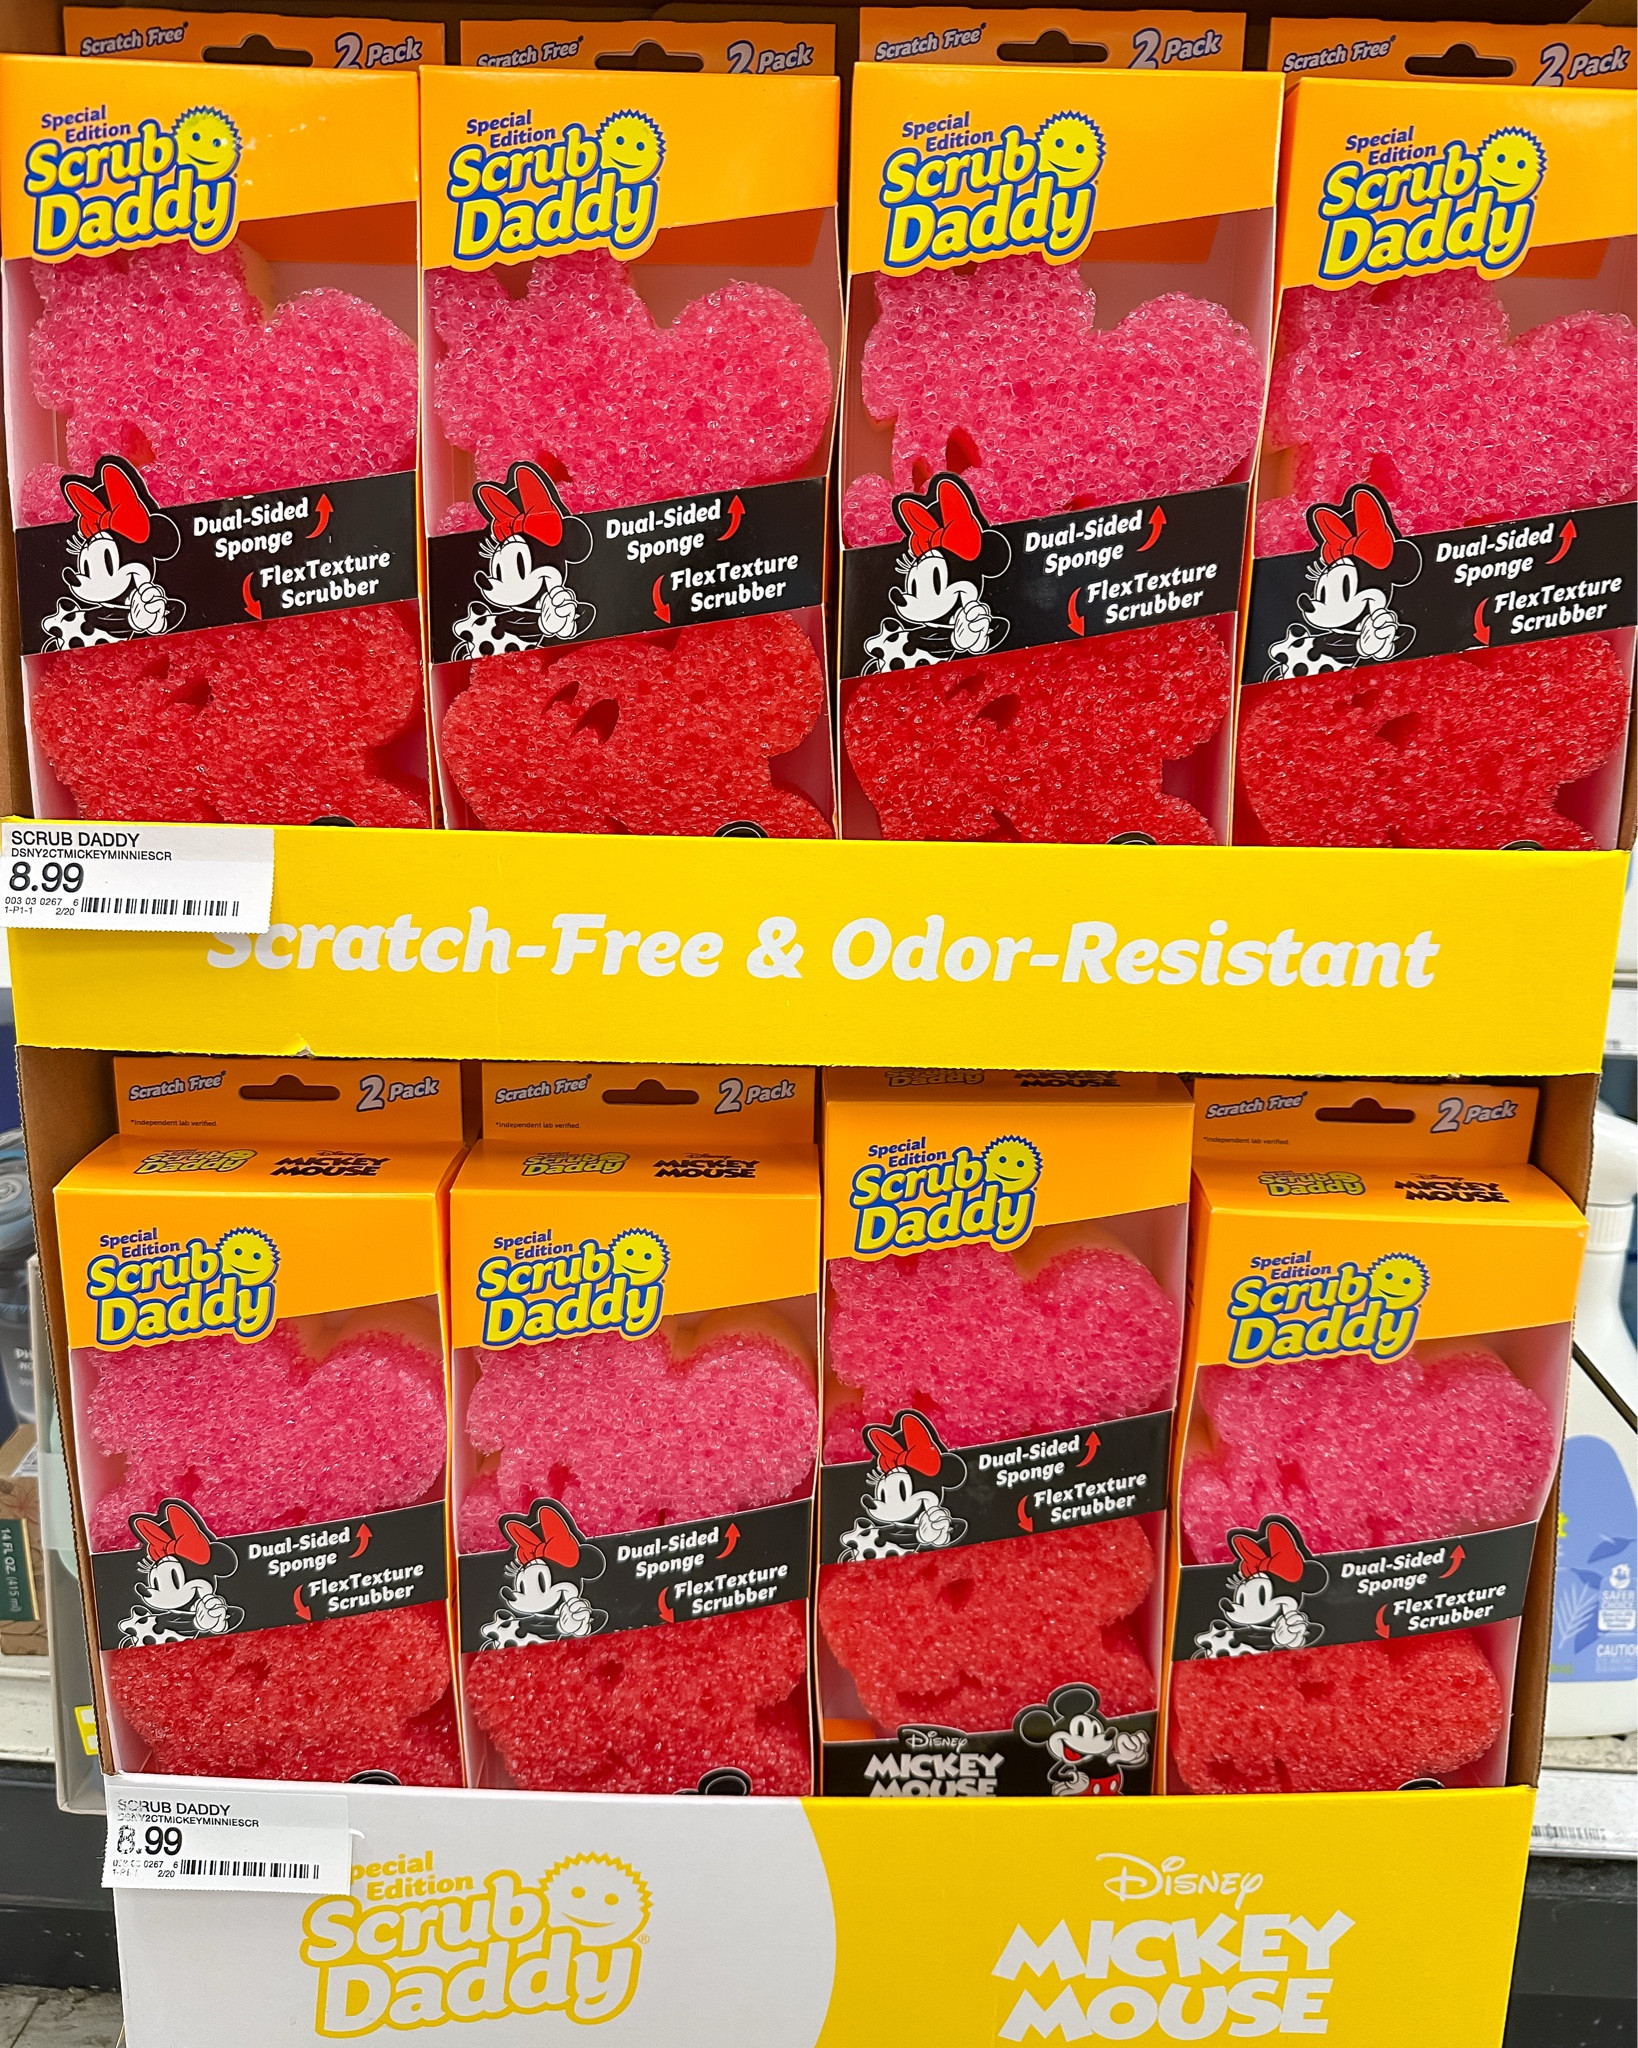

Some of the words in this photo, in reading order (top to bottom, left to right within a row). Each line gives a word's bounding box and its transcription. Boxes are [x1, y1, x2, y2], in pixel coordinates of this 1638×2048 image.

[81, 30, 142, 56] Scratch
[334, 32, 363, 69] 2
[365, 37, 421, 68] Pack
[477, 46, 537, 67] Scratch
[726, 39, 754, 74] 2
[757, 42, 813, 73] Pack
[875, 32, 939, 61] Scratch
[1129, 28, 1162, 69] 2
[1163, 30, 1222, 64] Pack
[1283, 46, 1347, 72] Scratch
[1532, 43, 1570, 86] 2
[1569, 46, 1630, 79] Pack
[41, 105, 106, 130] Special
[466, 110, 532, 136] Special
[902, 112, 970, 140] Special
[65, 123, 131, 143] Edition
[489, 126, 556, 148] Edition
[925, 129, 994, 152] Edition
[1346, 126, 1415, 152] Special
[26, 120, 177, 193] Scrub
[448, 124, 601, 198] Scrub
[881, 126, 1040, 206] Scrub
[1368, 144, 1436, 165] Edition
[1320, 141, 1482, 219] Scrub
[34, 165, 237, 255] Daddy
[454, 169, 657, 260] Daddy
[885, 173, 1096, 268] Daddy
[1319, 187, 1535, 280] Daddy
[193, 497, 309, 537] Dual-Sided
[606, 499, 721, 539] Dual-Sided
[1025, 510, 1143, 553] Dual-Sided
[215, 529, 293, 560] Sponge
[626, 533, 705, 564] Sponge
[1436, 523, 1554, 563] Dual-Sided
[260, 552, 391, 588] FlexTexture
[670, 554, 799, 591] FlexTexture
[1044, 544, 1124, 576] Sponge
[1454, 555, 1533, 586] Sponge
[281, 577, 379, 609] Scrubber
[690, 580, 786, 613] Scrubber
[1087, 564, 1218, 603] FlexTexture
[1494, 576, 1622, 614] FlexTexture
[1105, 589, 1203, 624] Scrubber
[1510, 601, 1607, 635] Scrubber
[11, 831, 72, 846] SCRUB
[79, 832, 140, 847] DADDY
[11, 848, 172, 861] DSNY2CTMICKEYMINNIESCR
[9, 862, 84, 892] 8.99
[5, 896, 22, 905] 003
[25, 897, 36, 905] 03
[5, 906, 33, 914] 1-P1-1
[746, 916, 804, 979] &
[831, 913, 1441, 989] Odor-Resistant
[129, 1077, 185, 1101] Scratch
[356, 1075, 385, 1112] 2
[388, 1076, 439, 1102] Pack
[495, 1081, 551, 1104] Scratch
[714, 1078, 743, 1114] 2
[745, 1079, 796, 1105] Pack
[1206, 1098, 1264, 1119] Scratch
[1430, 1097, 1464, 1133] 2
[1463, 1100, 1518, 1124] Pack
[142, 1150, 225, 1162] Scrub
[275, 1157, 391, 1166] MICKEY
[523, 1153, 599, 1165] Scrub
[868, 1137, 926, 1157] Special
[888, 1150, 947, 1167] Edition
[133, 1158, 247, 1174] Daddy
[270, 1166, 381, 1176] MOUSE
[521, 1160, 627, 1176] Daddy
[653, 1160, 760, 1168] MICKEY
[654, 1168, 756, 1178] MOUSE
[851, 1147, 987, 1208] Scrub
[1258, 1172, 1329, 1185] Scrub
[1267, 1180, 1366, 1196] Daddy
[1394, 1181, 1499, 1191] MICKEY
[1405, 1190, 1510, 1203] MOUSE
[855, 1179, 1033, 1254] Daddy
[100, 1228, 157, 1248] Special
[122, 1241, 180, 1258] Edition
[494, 1229, 552, 1249] Special
[514, 1242, 573, 1260] Edition
[87, 1238, 223, 1299] Scrub
[477, 1239, 614, 1300] Scrub
[1250, 1251, 1311, 1269] Special
[1271, 1263, 1331, 1280] Edition
[1228, 1262, 1371, 1321] Scrub
[97, 1273, 275, 1344] Daddy
[483, 1274, 663, 1345] Daddy
[1229, 1297, 1418, 1364] Daddy
[978, 1435, 1080, 1470] Dual-Sided
[996, 1461, 1065, 1488] Sponge
[1034, 1472, 1147, 1508] FlexTexture
[1050, 1494, 1136, 1524] Scrubber
[1, 1528, 12, 1540] 14
[3, 1542, 13, 1554] FL
[248, 1527, 351, 1560] Dual-Sided
[617, 1527, 720, 1562] Dual-Sided
[268, 1553, 337, 1577] Sponge
[635, 1553, 704, 1578] Sponge
[1341, 1549, 1445, 1580] Dual-Sided
[309, 1563, 424, 1597] FlexTexture
[674, 1563, 789, 1599] FlexTexture
[1357, 1571, 1428, 1596] Sponge
[328, 1583, 414, 1613] Scrubber
[692, 1584, 778, 1614] Scrubber
[1393, 1583, 1507, 1617] FlexTexture
[1407, 1603, 1493, 1632] Scrubber
[1597, 1644, 1638, 1657] CAUTIO
[901, 1728, 968, 1752] Disney
[864, 1753, 1004, 1780] MICKEY
[870, 1778, 997, 1797] MOUSE
[117, 1799, 172, 1813] SCRUB
[176, 1804, 231, 1816] DADDY
[117, 1825, 183, 1855] 8.99
[144, 1860, 164, 1868] 0267
[352, 1850, 433, 1884] pecial
[366, 1873, 474, 1901] Edition
[1095, 1852, 1263, 1911] Disney
[300, 1869, 550, 1966] Scrub
[991, 1910, 1356, 1981] MICKEY
[315, 1925, 643, 2039] Daddy
[997, 1977, 1333, 2043] MOUSE
